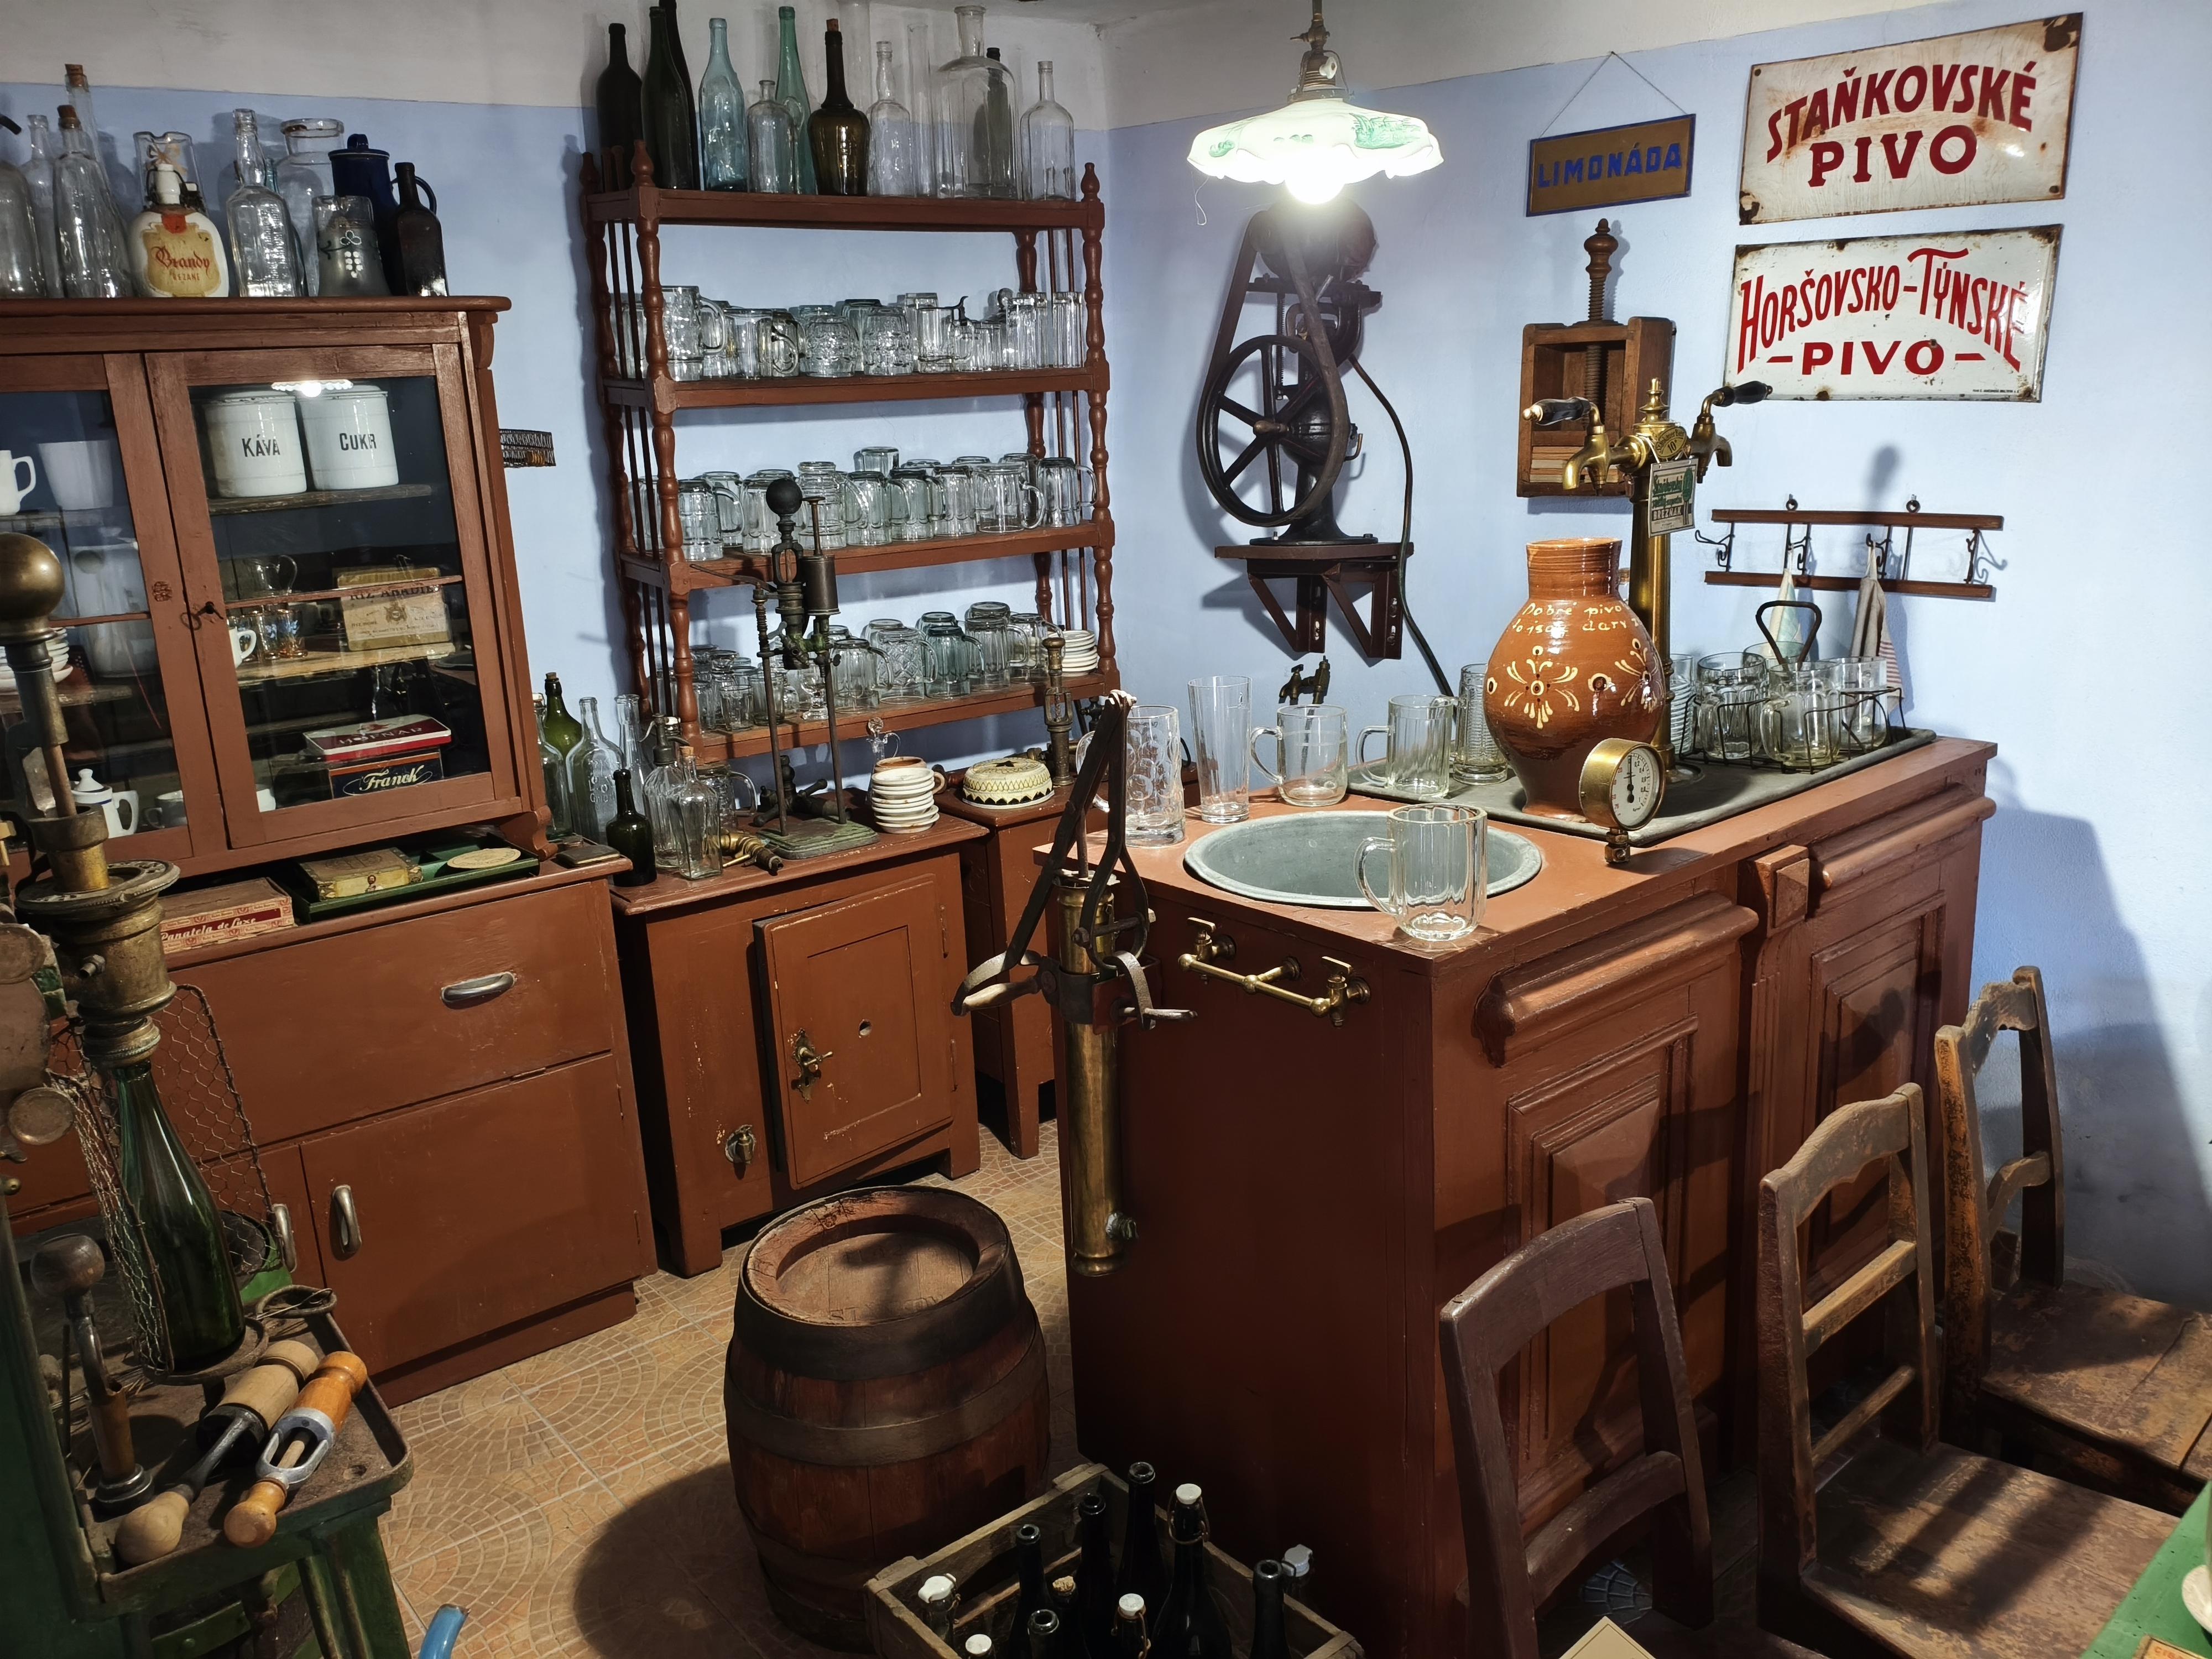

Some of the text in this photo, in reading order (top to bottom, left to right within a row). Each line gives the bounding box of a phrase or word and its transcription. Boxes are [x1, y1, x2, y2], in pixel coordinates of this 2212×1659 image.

[1767, 61, 2037, 163] STAŇKOVSKÉ
[1537, 142, 1682, 188] LIMONÁDA
[1808, 125, 1978, 187] PIVO
[152, 246, 210, 275] Brandy
[1738, 248, 2028, 375] HORŠOVSKO-TÝNSKÉ
[242, 434, 280, 457] KÁVA
[339, 433, 377, 451] CUKR
[1584, 604, 1622, 621] pivo
[359, 765, 424, 791] Franck
[160, 924, 213, 941] Panatela
